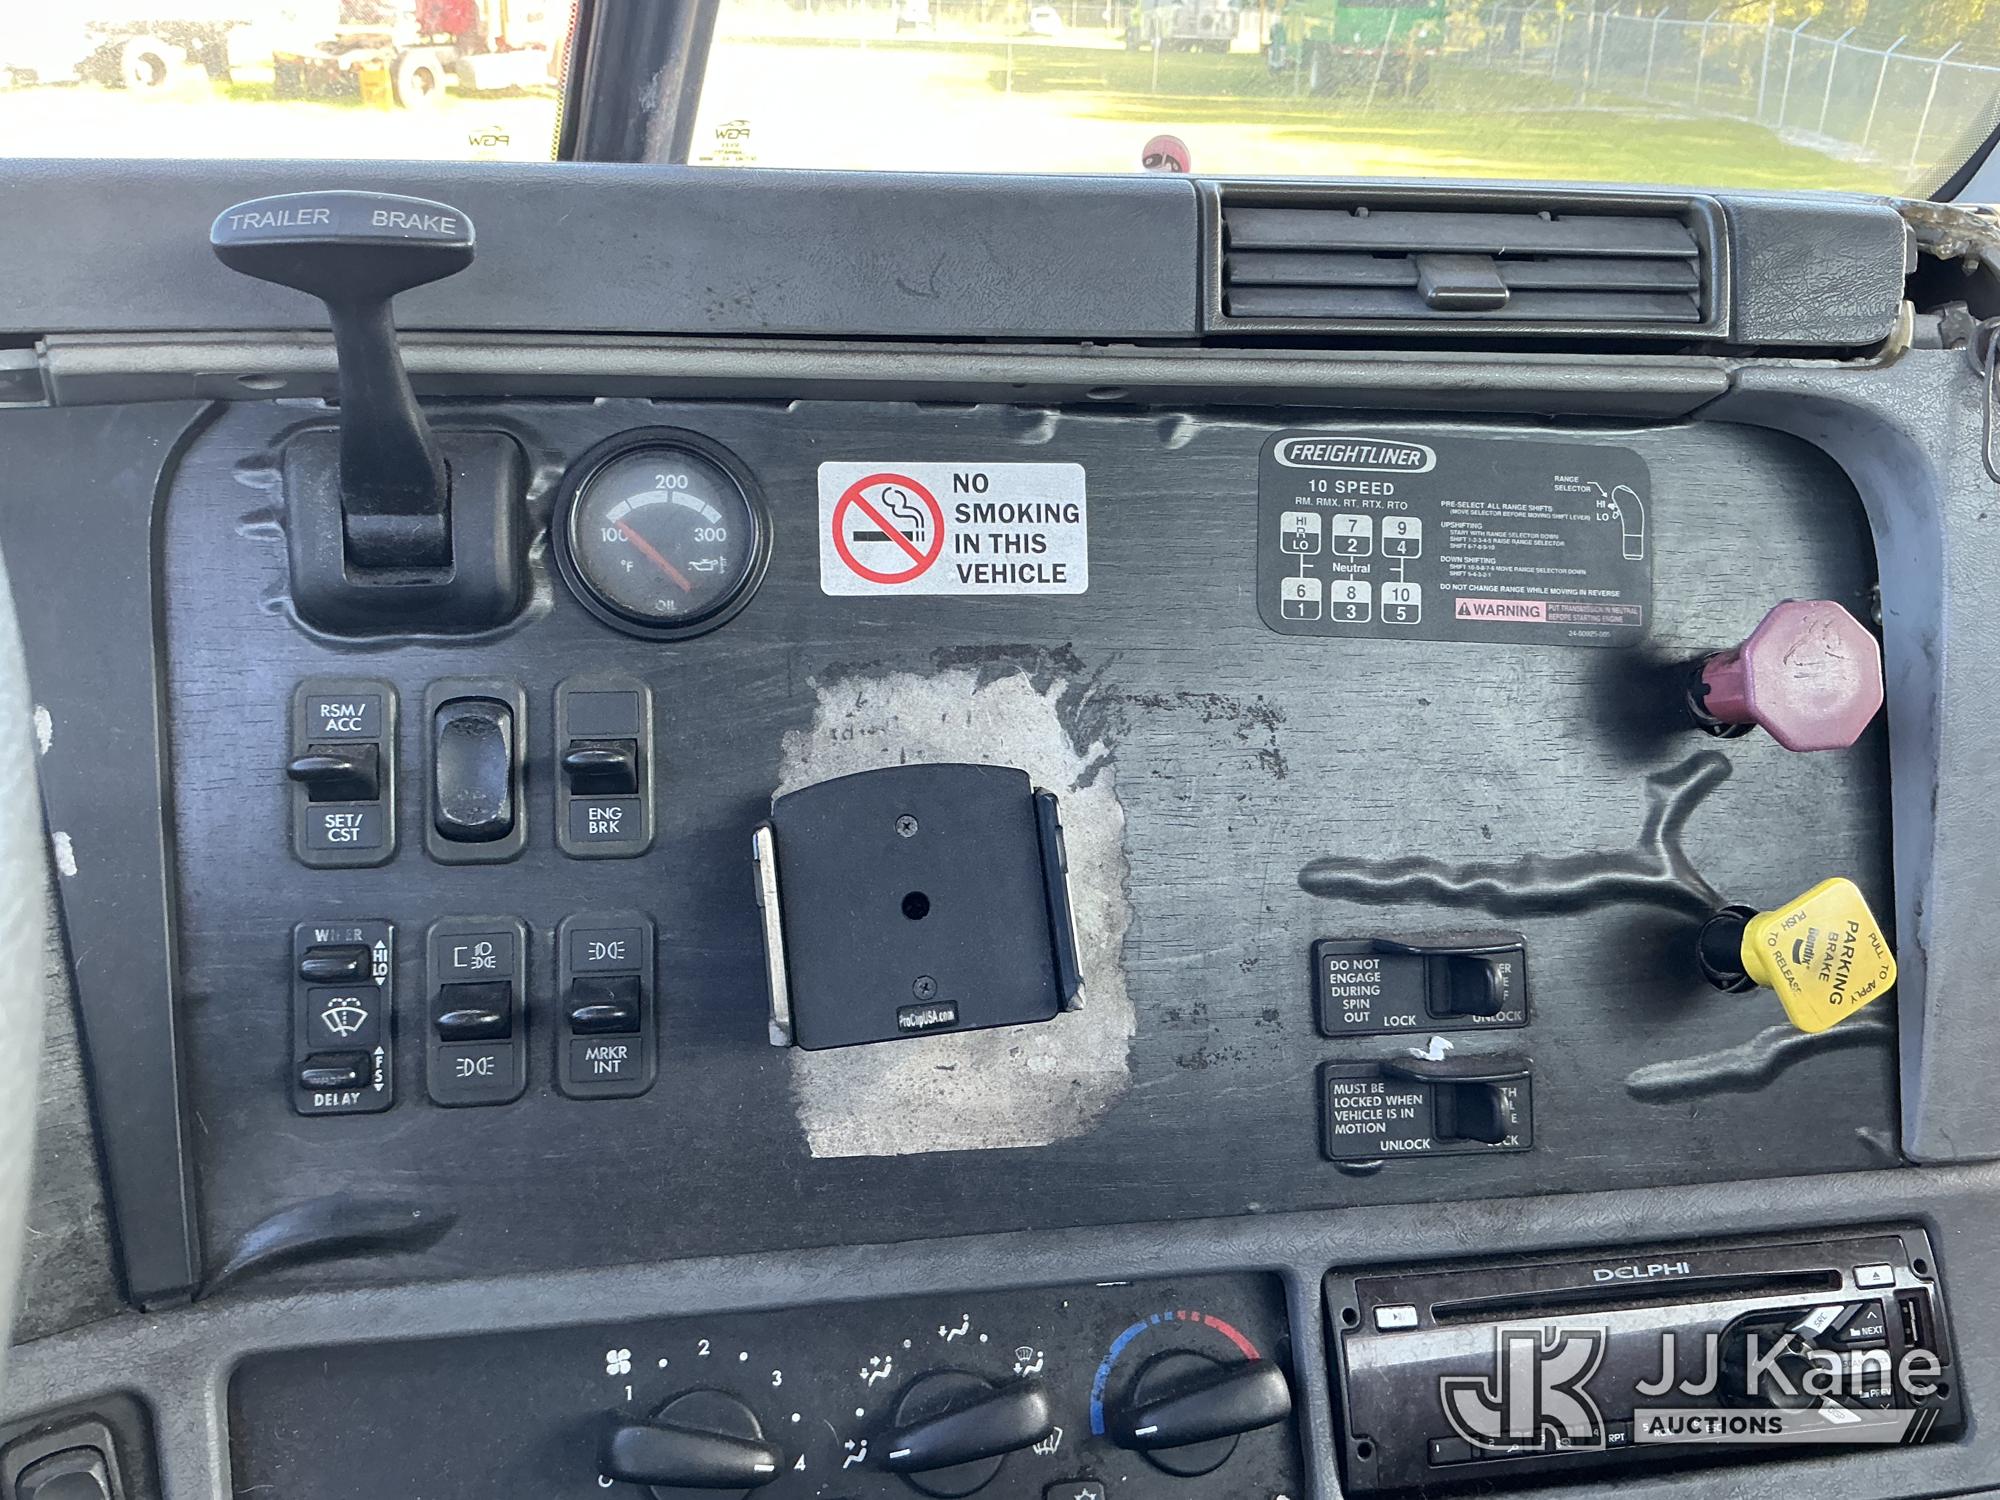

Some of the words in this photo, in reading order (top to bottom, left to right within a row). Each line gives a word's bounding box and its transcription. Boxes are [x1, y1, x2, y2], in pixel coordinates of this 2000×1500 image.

[229, 208, 330, 230] TRAILER
[372, 210, 456, 235] BRAKE
[1290, 444, 1421, 466] FREIGHTLINER
[655, 474, 688, 489] 200
[953, 473, 989, 493] NO
[1554, 475, 1579, 483] RANGE
[1308, 479, 1328, 493] 10
[1335, 480, 1395, 496] SPEED
[1554, 484, 1591, 492] SELECTOR
[1387, 500, 1408, 511] RTO
[1440, 500, 1485, 509] PRE-SELECT
[1487, 502, 1500, 510] ALL
[1502, 503, 1527, 511] RANGE
[1528, 504, 1553, 512] SHIFTS
[1596, 500, 1606, 508] HI
[955, 503, 1080, 523] SMOKING
[1596, 512, 1609, 521] LO
[1296, 516, 1307, 526] HI
[1348, 519, 1358, 533] 7
[1440, 521, 1483, 530] UPSHIFTING
[601, 527, 629, 542] 100
[694, 527, 727, 542] 300
[1296, 527, 1306, 539] R
[1397, 521, 1407, 536] 9
[955, 533, 980, 554] IN
[988, 533, 1047, 554] THIS
[1293, 540, 1309, 550] LO
[1347, 538, 1358, 552] 2
[1396, 540, 1407, 554] 4
[1440, 555, 1463, 563] DOWN
[1463, 556, 1497, 565] SHIFTING
[956, 563, 1067, 584] VEHICLE
[1332, 562, 1371, 573] Neutral
[1296, 584, 1307, 598] 6
[1346, 586, 1356, 600] 8
[1391, 587, 1410, 602] 10
[1452, 583, 1468, 591] NOT
[1468, 584, 1499, 592] CHANGE
[1500, 585, 1525, 593] RANGE
[1526, 586, 1548, 594] WHILE
[1550, 587, 1578, 596] MOVING
[1579, 588, 1587, 596] IN
[1588, 589, 1621, 598] REVERSE
[655, 600, 677, 611] OIL
[1297, 603, 1304, 617] 1
[1346, 604, 1356, 619] 3
[1473, 602, 1541, 618] WARNING
[1396, 606, 1407, 621] 5
[320, 702, 366, 718] RSM/
[325, 717, 362, 732] ACC
[324, 813, 363, 829] SET/
[588, 807, 623, 821] ENG
[588, 820, 620, 834] BRK
[328, 827, 360, 842] CST
[1767, 931, 1779, 947] TO
[1867, 932, 1883, 960] PULL
[373, 949, 388, 962] HI
[1818, 931, 1840, 983] BRAKE
[373, 963, 388, 977] LO
[1330, 960, 1349, 971] DO
[1353, 959, 1380, 970] NOT
[1829, 920, 1859, 1006] PARKING
[1330, 971, 1381, 984] ENGAGE
[1879, 964, 1890, 980] TO
[1331, 985, 1381, 997] DURING
[1850, 979, 1877, 1005] APPLY
[1342, 998, 1370, 1010] SPIN
[1343, 1011, 1371, 1023] OUT
[1383, 1015, 1417, 1027] LOCK
[585, 1046, 628, 1060] MRKR
[375, 1056, 383, 1068] F
[594, 1060, 622, 1074] INT
[375, 1069, 383, 1082] S
[1333, 1083, 1368, 1095] MUST
[1370, 1083, 1385, 1093] BE
[314, 1092, 361, 1107] DELAY
[1334, 1096, 1382, 1108] LOCKED
[1385, 1094, 1423, 1106] WHEN
[1334, 1109, 1383, 1121] VEHICLE
[1386, 1108, 1398, 1119] IS
[1400, 1107, 1415, 1118] IN
[1335, 1122, 1386, 1134] MOTION
[1380, 1138, 1431, 1151] UNLOCK
[1592, 1261, 1690, 1281] DELPHI
[1861, 1325, 1884, 1336] NEXT
[698, 1339, 710, 1356] 2
[771, 1370, 783, 1387] 3
[625, 1385, 633, 1401] 1
[793, 1453, 806, 1471] 4
